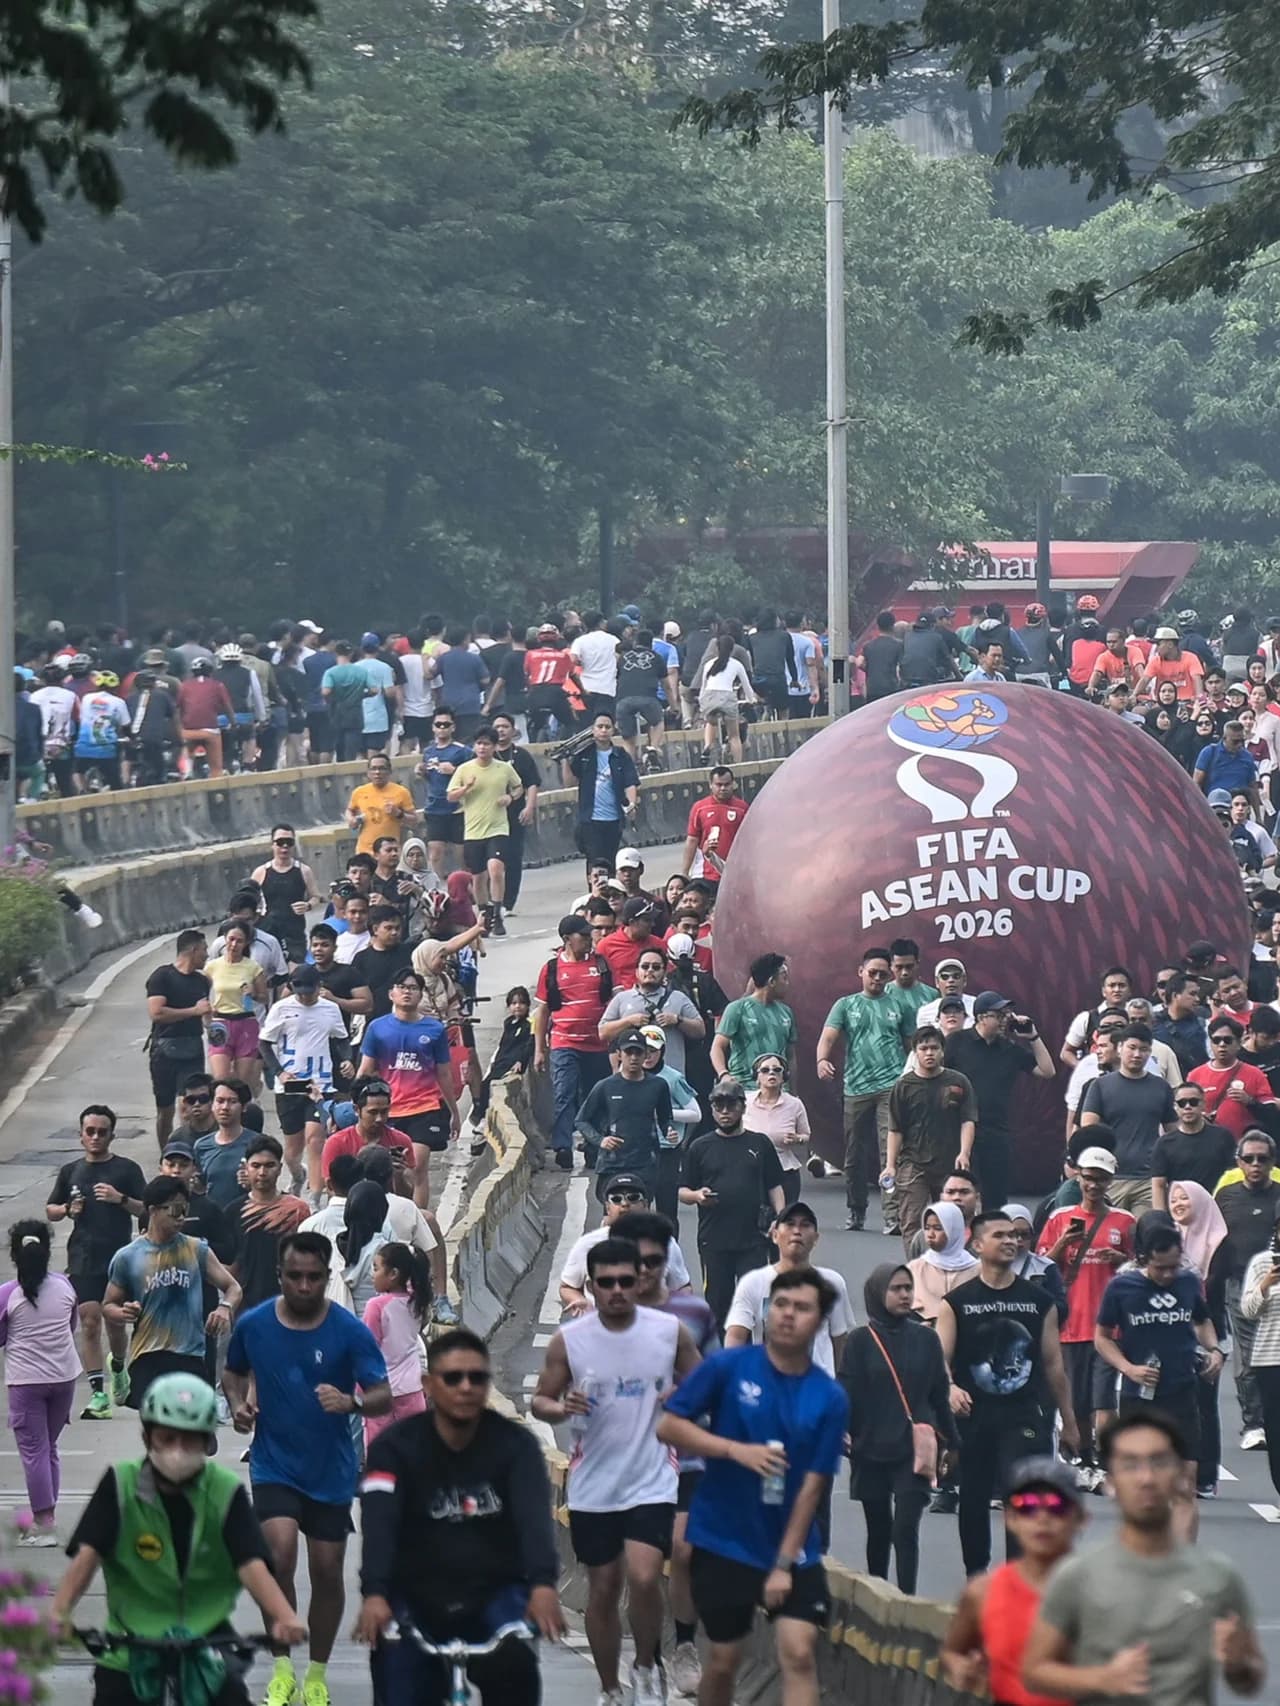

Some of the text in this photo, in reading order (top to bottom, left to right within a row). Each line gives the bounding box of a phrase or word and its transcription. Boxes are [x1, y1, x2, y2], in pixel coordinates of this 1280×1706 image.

[537, 660, 557, 684] 11
[916, 827, 1019, 868] FIFA
[861, 865, 1091, 929] ASEAN CUP
[935, 908, 1013, 942] 2026
[144, 1266, 190, 1294] JAKARTA
[963, 1300, 1039, 1315] DREAM THEATER
